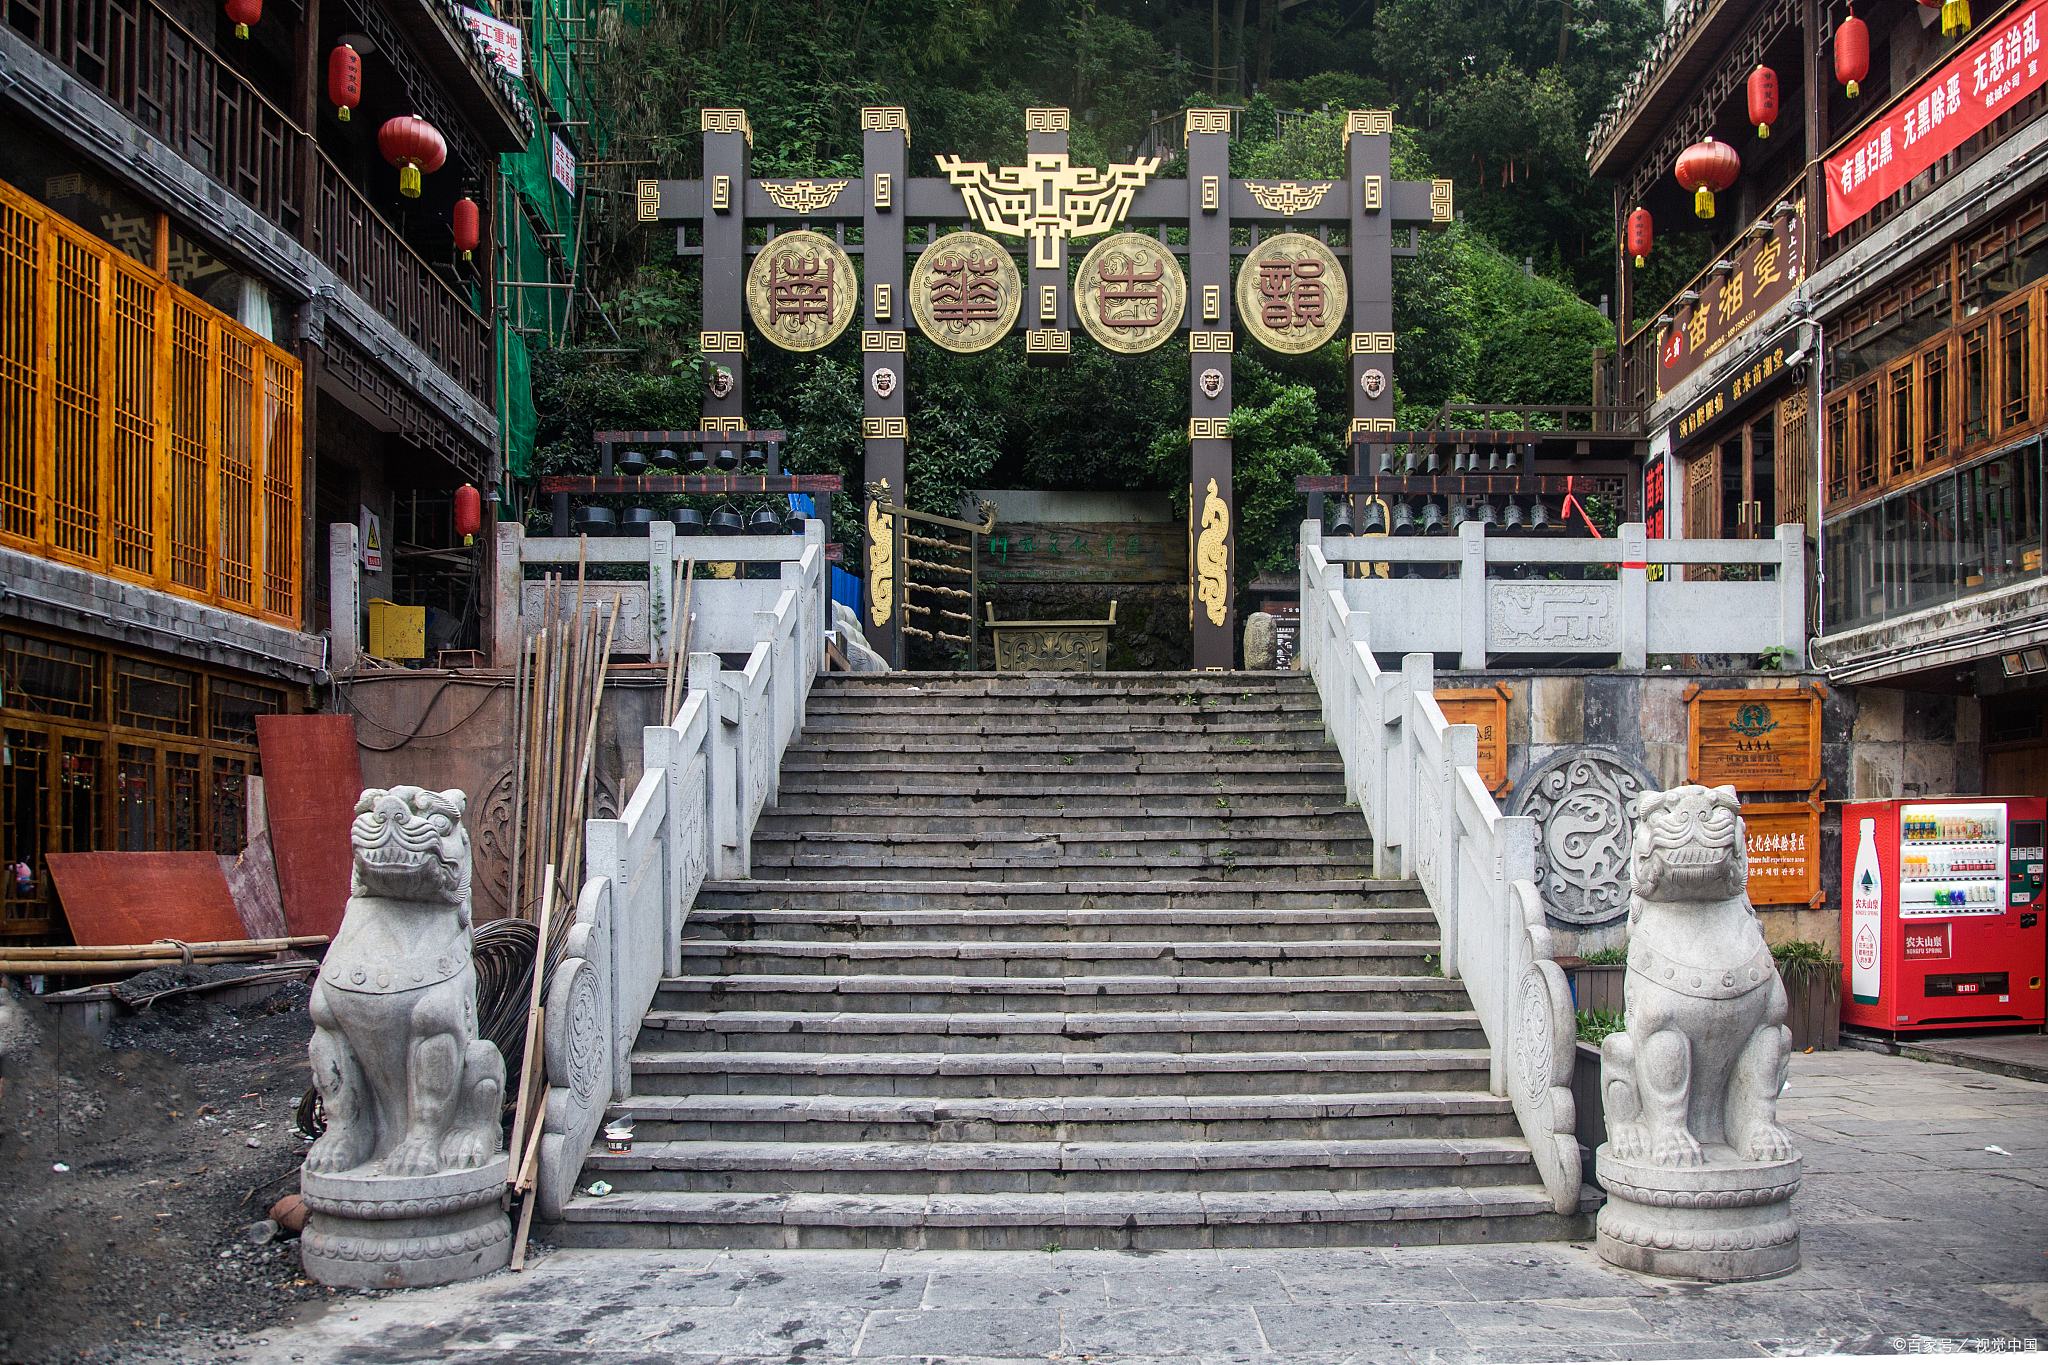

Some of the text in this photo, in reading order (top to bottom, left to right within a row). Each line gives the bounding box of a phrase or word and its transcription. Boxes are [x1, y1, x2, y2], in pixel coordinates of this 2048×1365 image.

[1841, 10, 2040, 195] 有黑扫黑 无黑除恶 无恶治乱
[1687, 236, 1782, 355] 苗湘堂
[1043, 570, 1085, 578] CULTURAL
[1736, 740, 1771, 751] AAAA
[1479, 751, 1492, 759] Park
[1855, 898, 1879, 910] 农夫山泉
[1905, 936, 1943, 948] 农夫山泉
